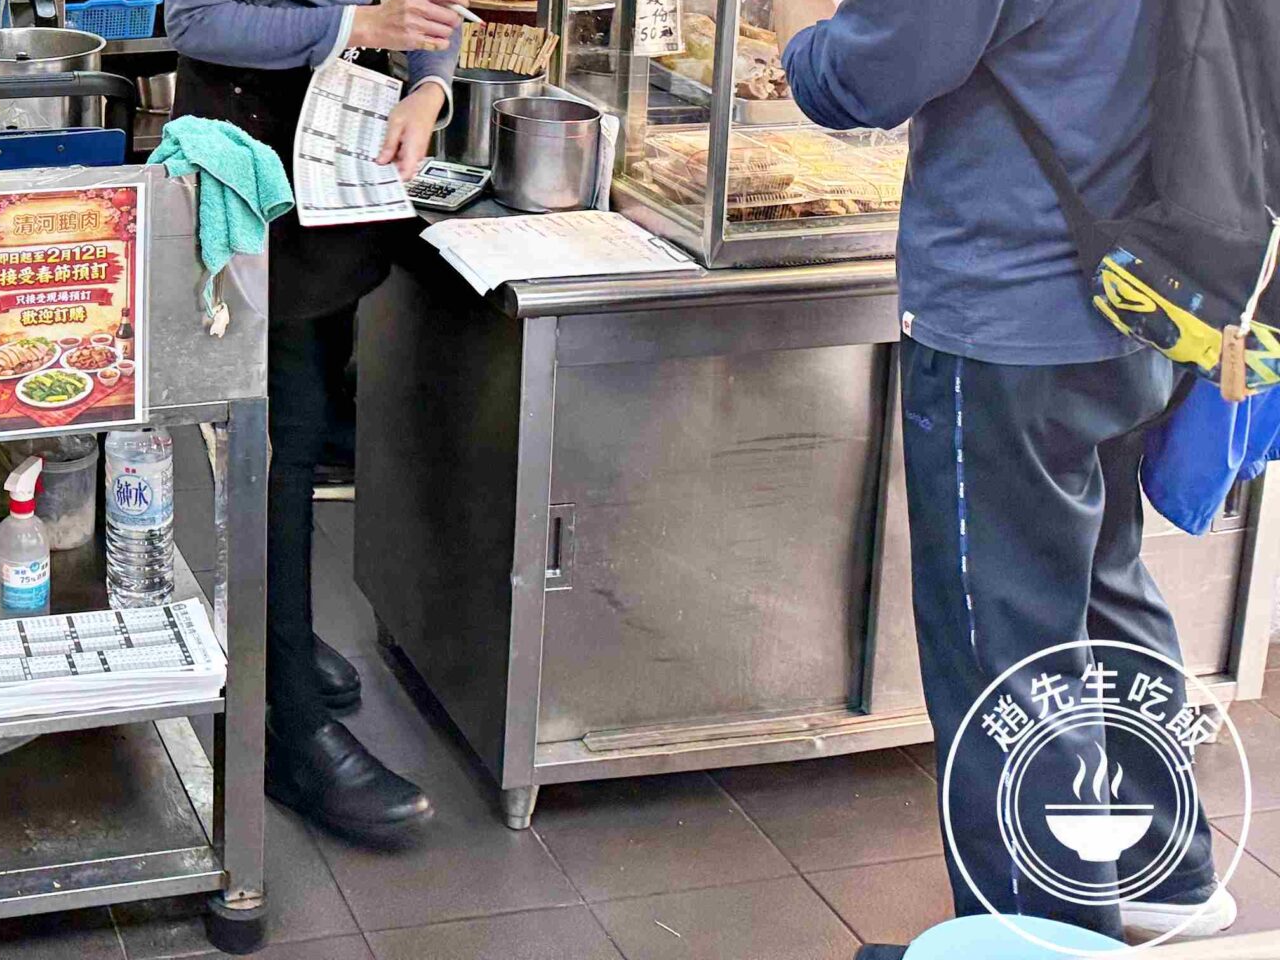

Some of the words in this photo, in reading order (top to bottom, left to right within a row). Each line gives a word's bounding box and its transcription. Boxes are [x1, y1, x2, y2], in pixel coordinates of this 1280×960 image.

[15, 290, 92, 306] 只接受現場預訂
[20, 306, 88, 327] 歡迎訂購
[116, 478, 149, 508] 純水
